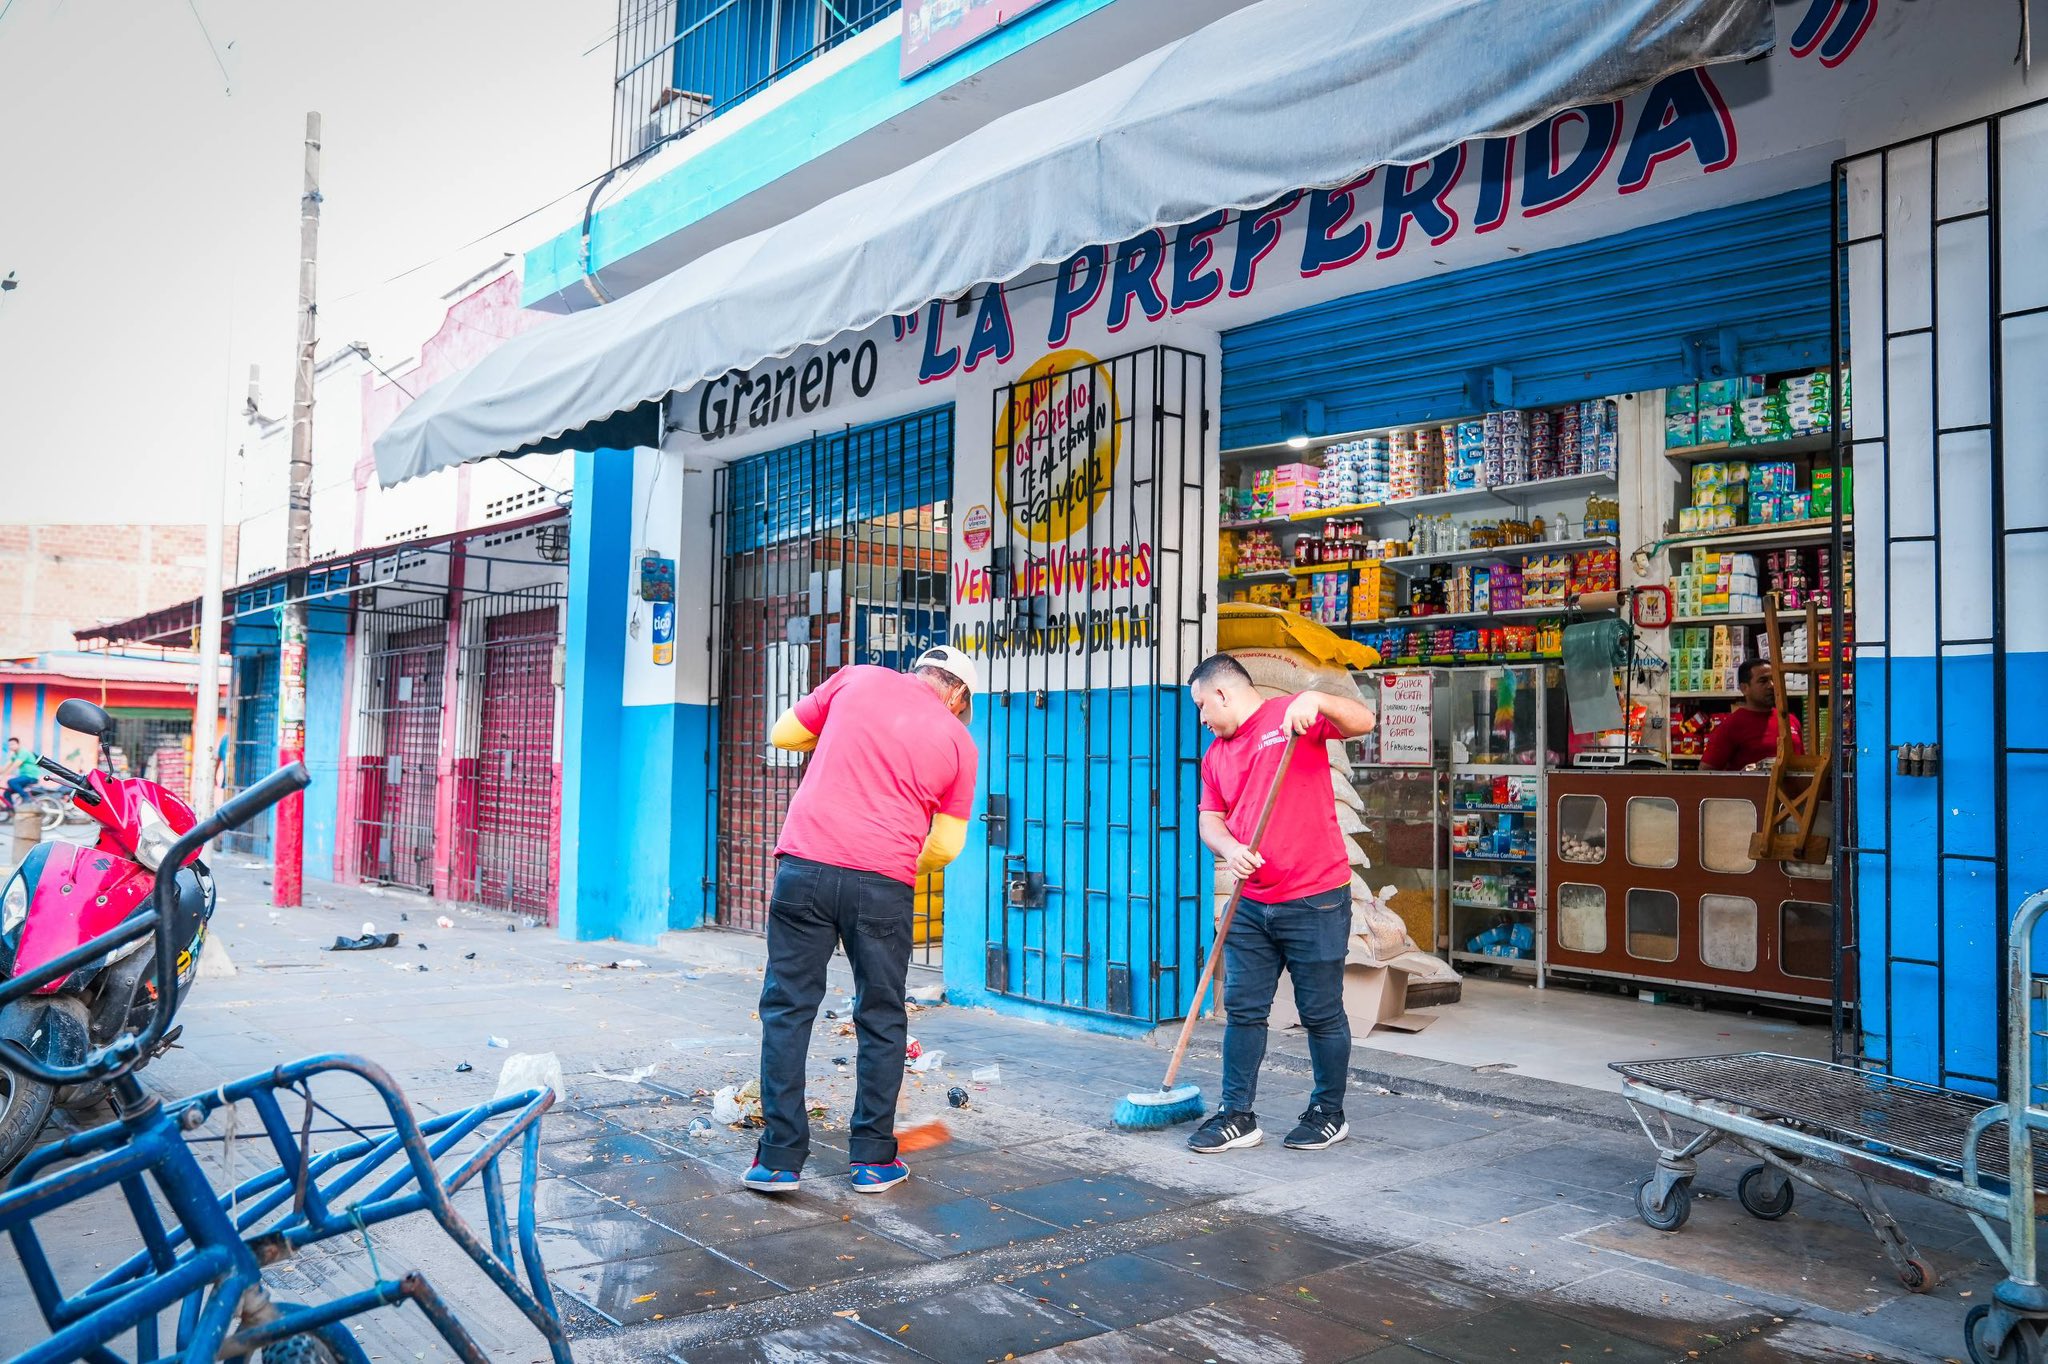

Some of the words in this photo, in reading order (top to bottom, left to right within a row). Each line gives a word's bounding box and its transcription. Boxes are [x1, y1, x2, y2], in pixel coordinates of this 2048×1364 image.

[699, 338, 878, 442] Granero
[1013, 363, 1058, 432] DONDE
[1007, 436, 1032, 472] OS
[1034, 383, 1092, 451] PRECIO
[1020, 467, 1036, 498] TE
[953, 558, 1020, 606] VENA
[653, 612, 672, 638] tigo
[975, 617, 1007, 661] POR
[1394, 689, 1423, 702] OFERTA
[1396, 677, 1424, 690] SUPER
